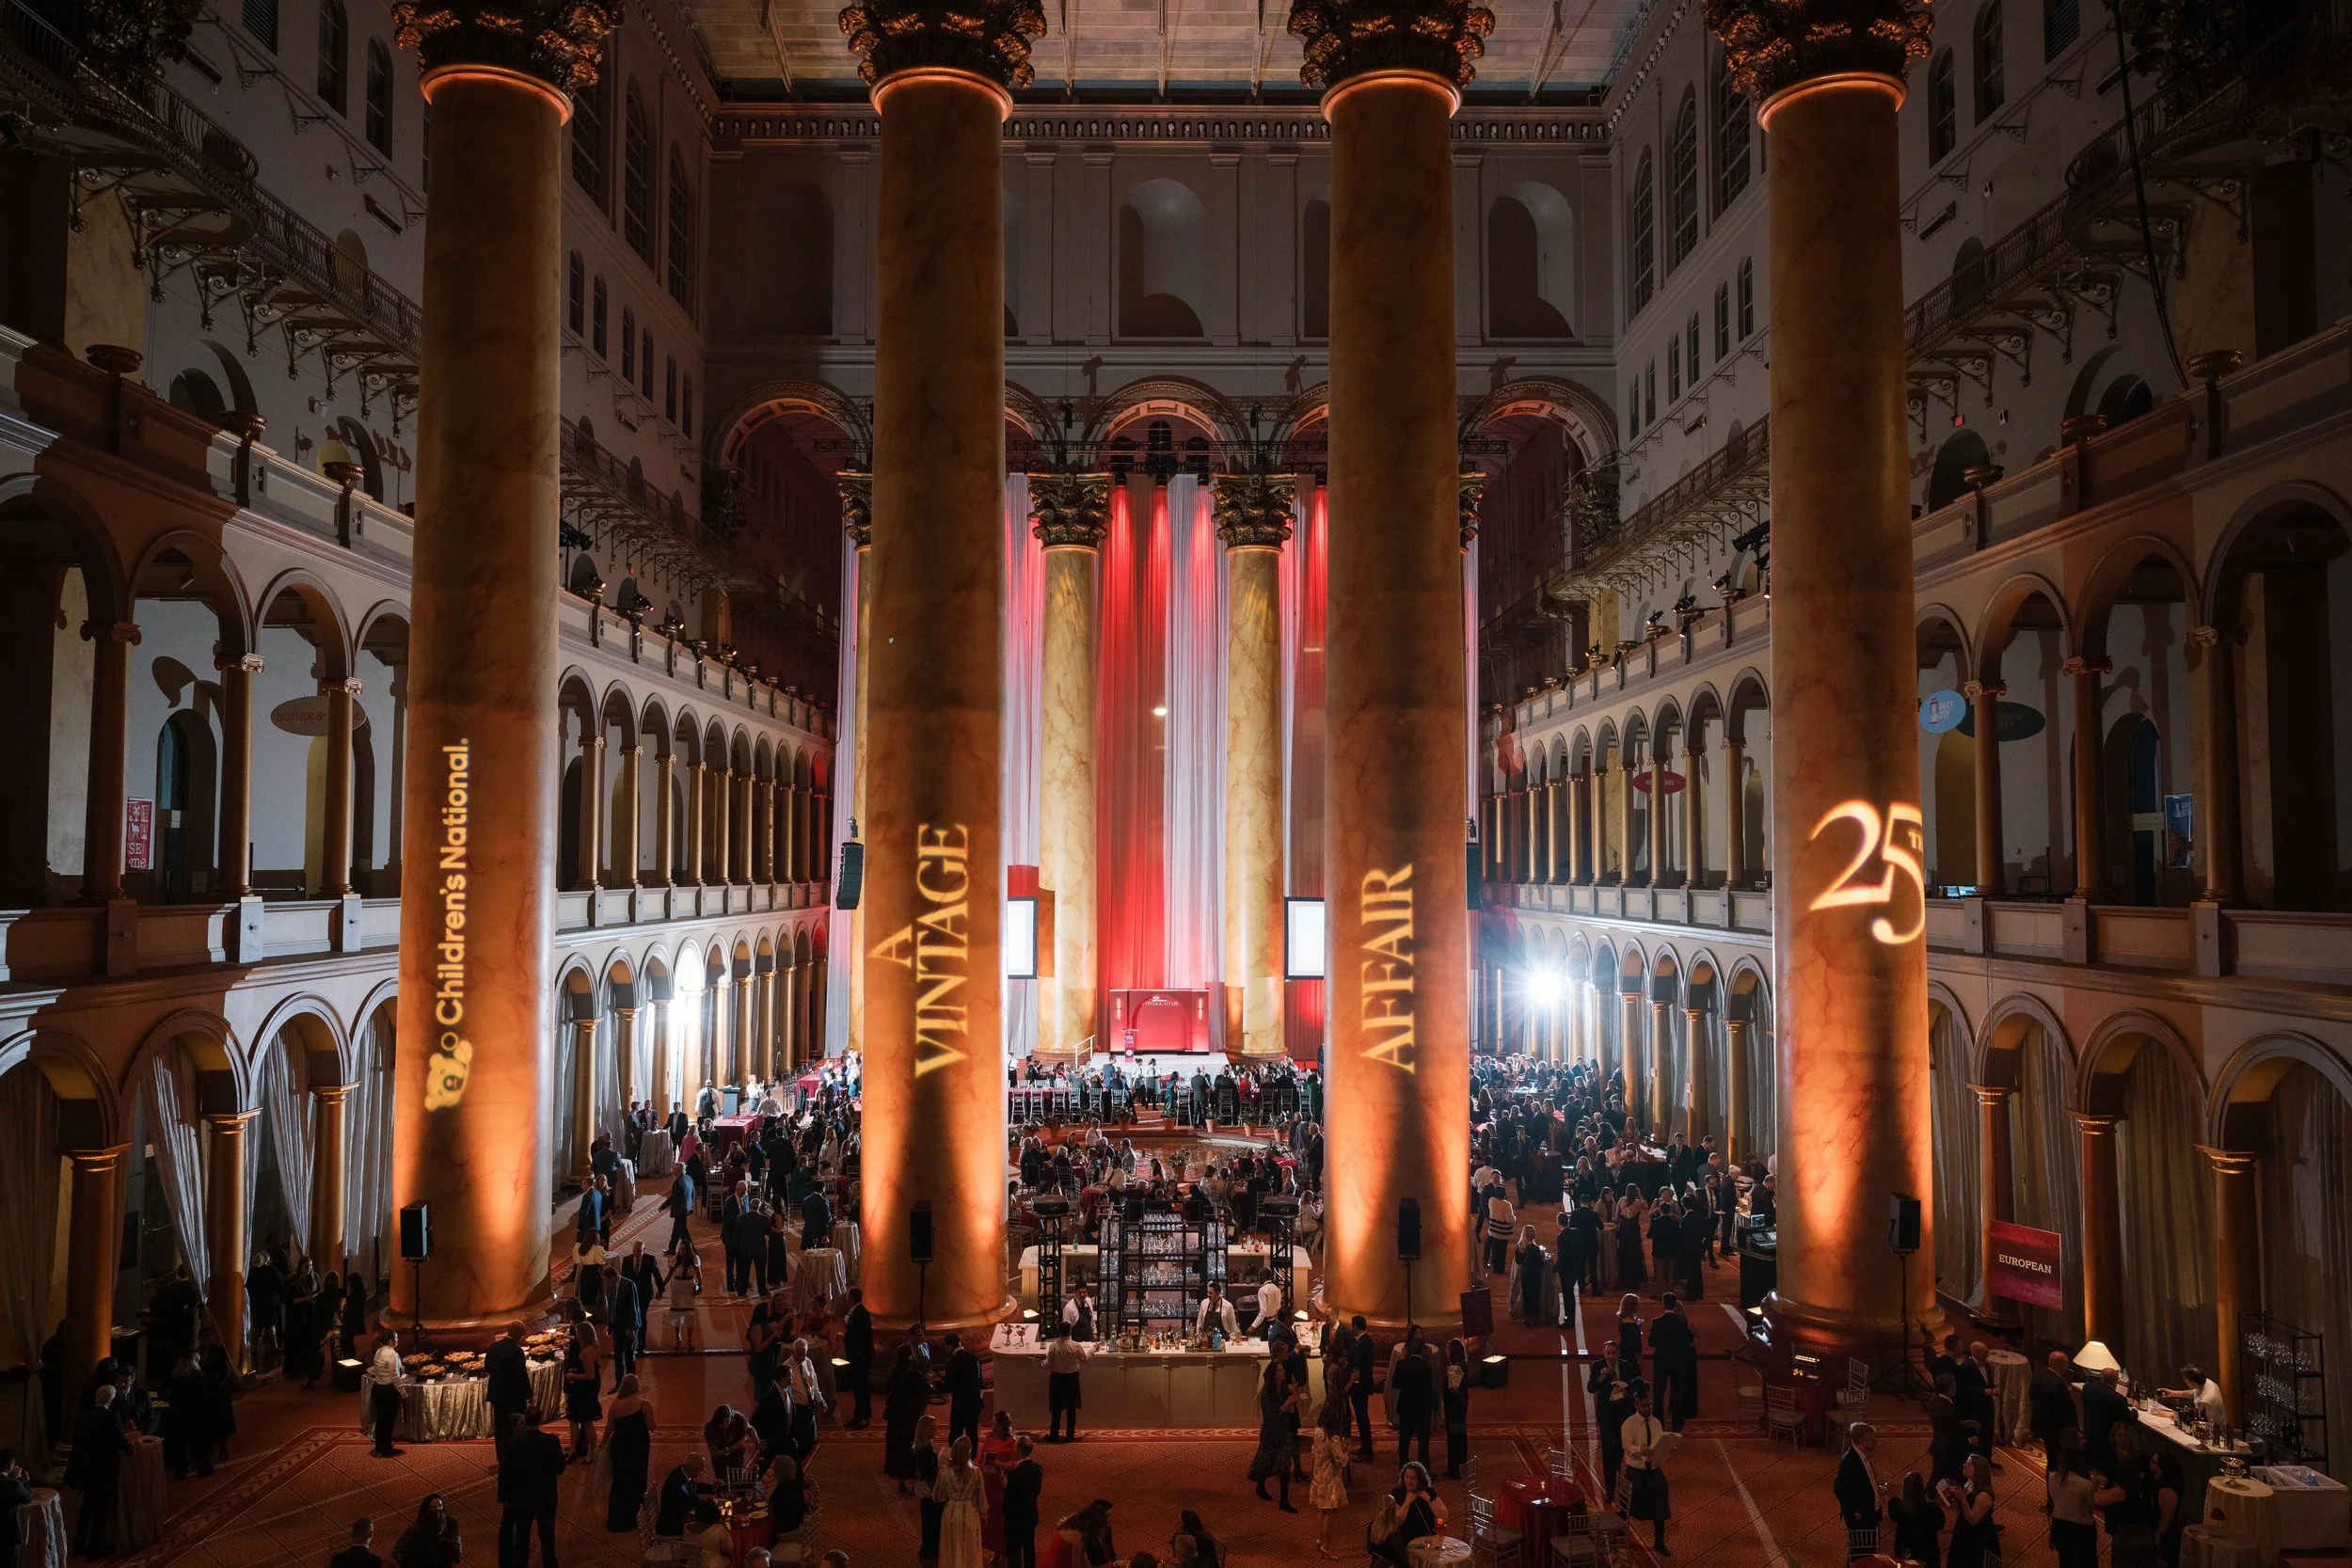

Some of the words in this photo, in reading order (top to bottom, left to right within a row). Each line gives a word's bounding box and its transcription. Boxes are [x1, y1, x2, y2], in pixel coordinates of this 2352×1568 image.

[1808, 799, 1925, 944] 25
[436, 873, 467, 1025] Children's
[866, 924, 913, 970] A
[914, 823, 969, 1079] VINTAGE
[1360, 863, 1416, 1075] AFFAIR
[1998, 1254, 2052, 1275] EUROPEAN
